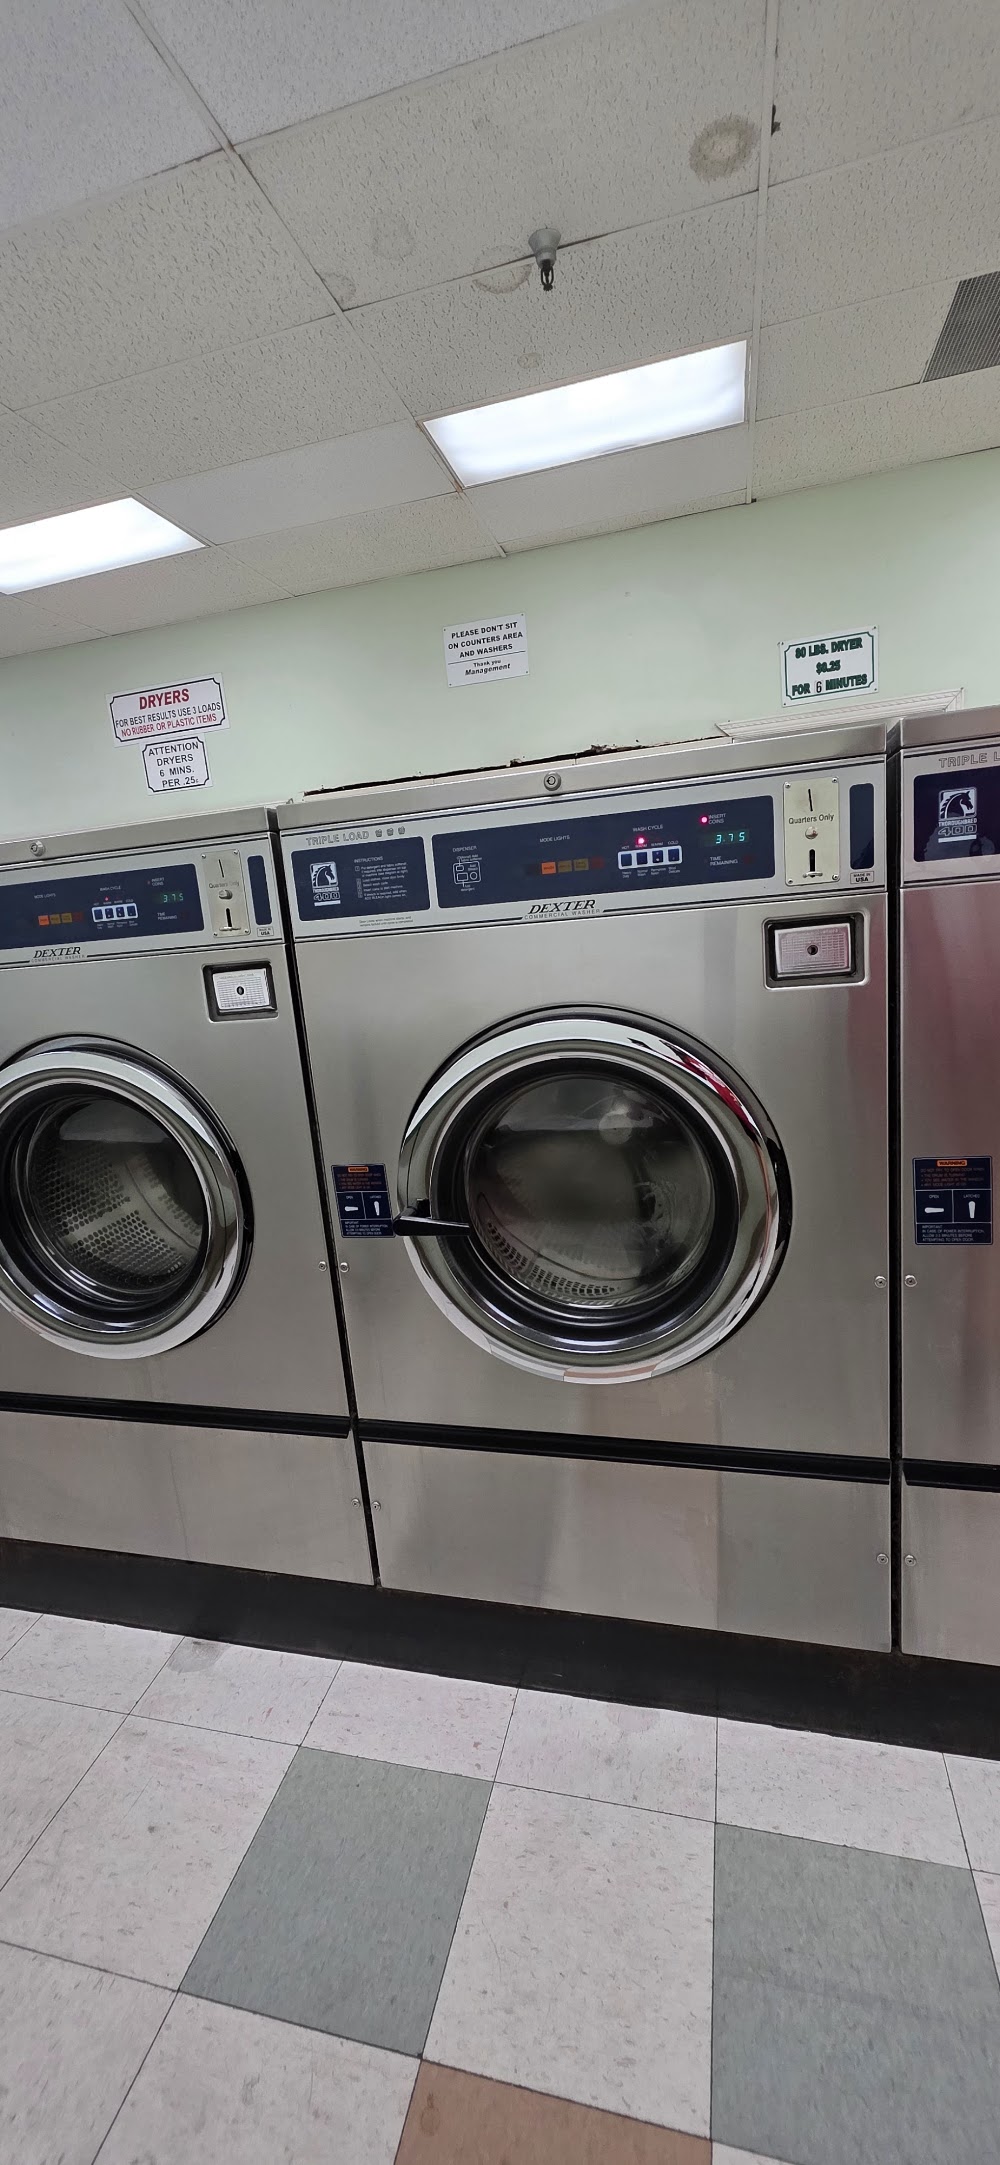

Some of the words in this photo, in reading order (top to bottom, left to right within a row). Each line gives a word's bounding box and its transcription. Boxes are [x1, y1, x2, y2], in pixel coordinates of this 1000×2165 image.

[452, 629, 479, 639] PLEASE
[481, 624, 503, 634] DON'T
[461, 635, 500, 648] COUNTERS
[503, 632, 523, 640] AREA
[809, 643, 829, 657] LBS.
[831, 637, 863, 652] DRYER
[476, 644, 513, 655] WASHERS
[465, 664, 511, 675] Management
[792, 683, 811, 696] FOR
[816, 681, 822, 693] 6
[826, 674, 867, 691] MINUTES
[139, 688, 189, 710] DRYERS
[116, 719, 128, 728] FOR
[130, 715, 146, 725] BEST
[148, 710, 176, 722] RESULTS
[178, 708, 191, 717] USE
[198, 702, 221, 714] LOADS
[121, 728, 132, 737] NO
[133, 724, 155, 735] RUBBER
[157, 722, 166, 731] OR
[168, 718, 195, 729] PLASTIC
[197, 713, 217, 724] ITEMS
[148, 742, 199, 756] ATTENTION
[157, 754, 194, 766] DRYERS
[939, 753, 987, 768] TRIPLE
[170, 766, 194, 775] MINS.
[162, 778, 180, 788] PER
[789, 816, 817, 824] Quarters
[938, 824, 977, 836] 400
[306, 834, 340, 846] TRIPLE
[343, 831, 370, 841] LOAD
[716, 832, 745, 844] 3.75
[314, 892, 340, 901] 400
[528, 899, 596, 914] DEXTER
[33, 947, 81, 958] DEXTER
